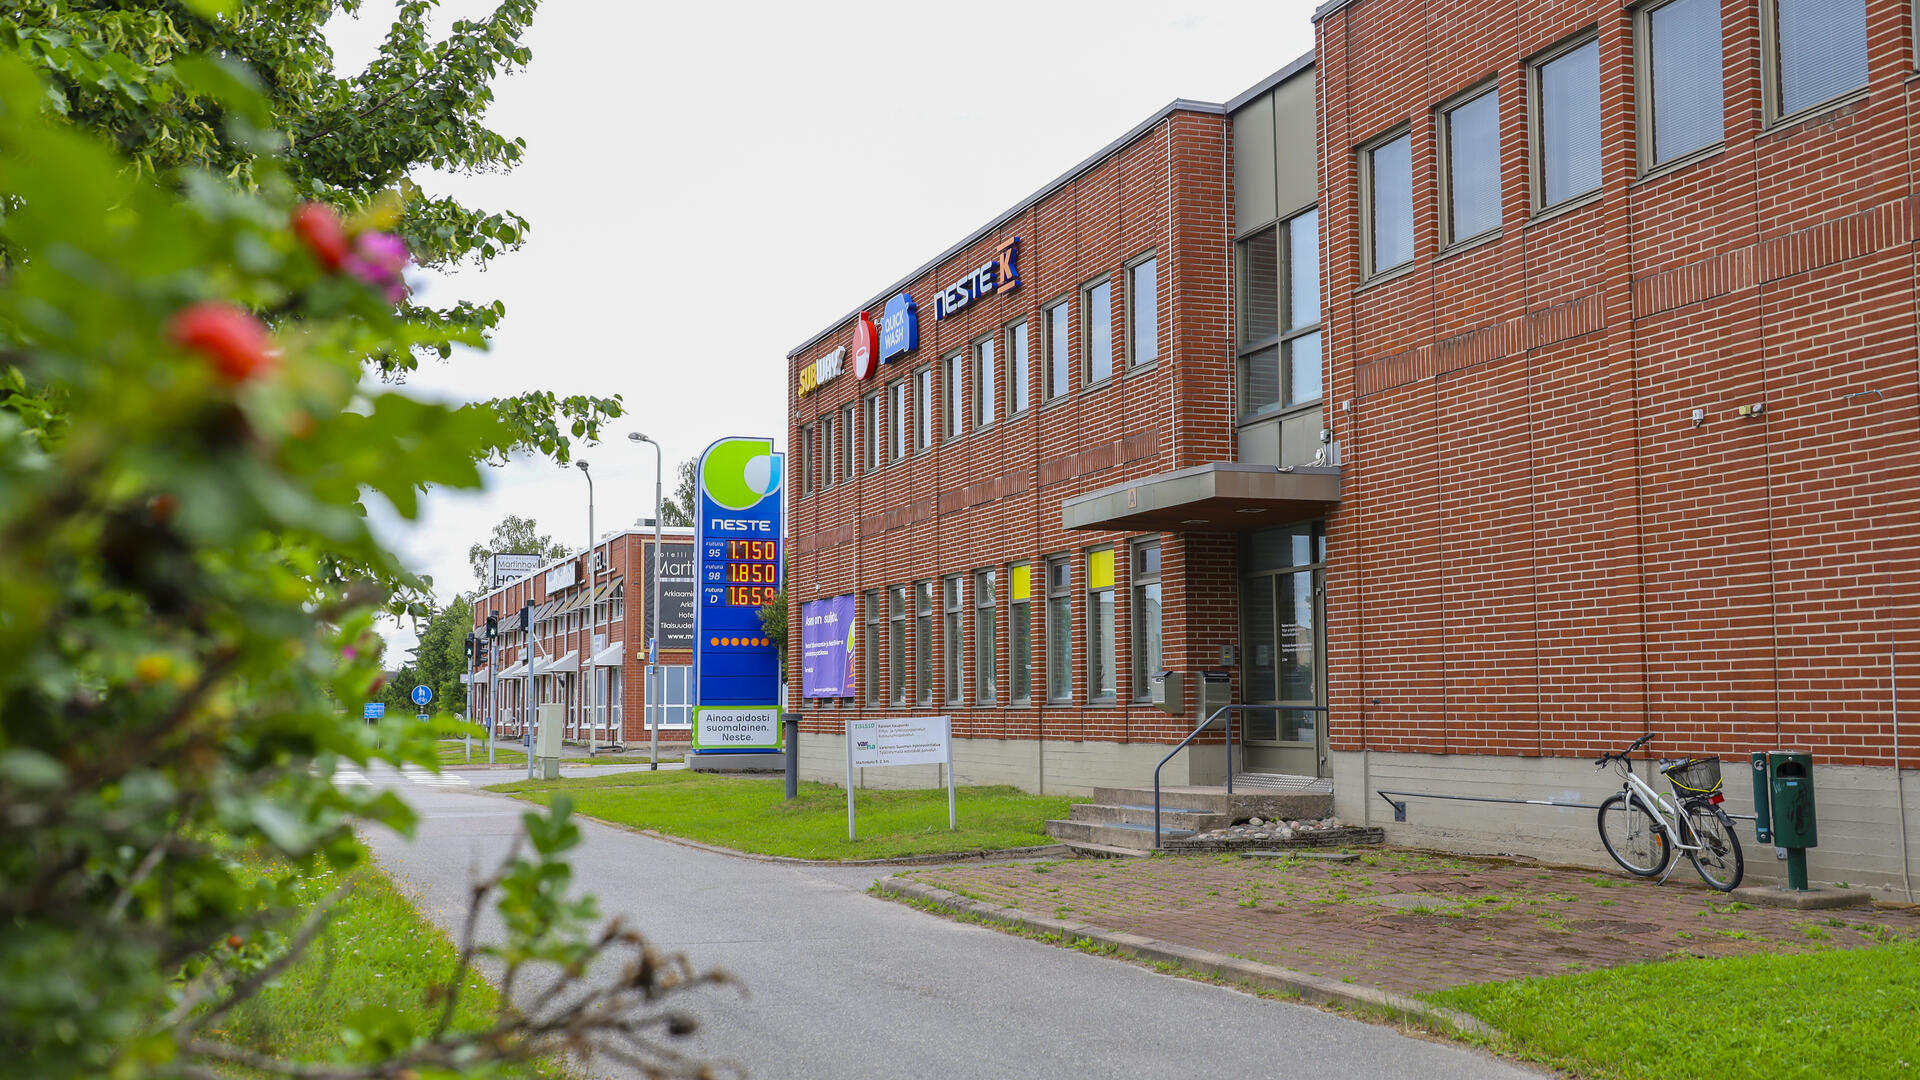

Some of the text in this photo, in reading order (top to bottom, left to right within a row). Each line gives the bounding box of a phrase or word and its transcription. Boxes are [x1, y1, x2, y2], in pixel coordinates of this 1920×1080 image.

[934, 260, 996, 320] NESTE
[884, 309, 904, 334] QUICK
[884, 326, 904, 350] WASH
[798, 345, 846, 398] SUBWAY
[711, 518, 771, 532] NESTE
[708, 540, 775, 560] 95 1.750
[708, 572, 721, 580] 98
[730, 563, 775, 583] 1.850
[710, 586, 775, 606] D 1.659
[706, 713, 770, 722] Ainoa aidosti
[706, 723, 769, 732] suomalainen.
[722, 733, 754, 741] Neste.
